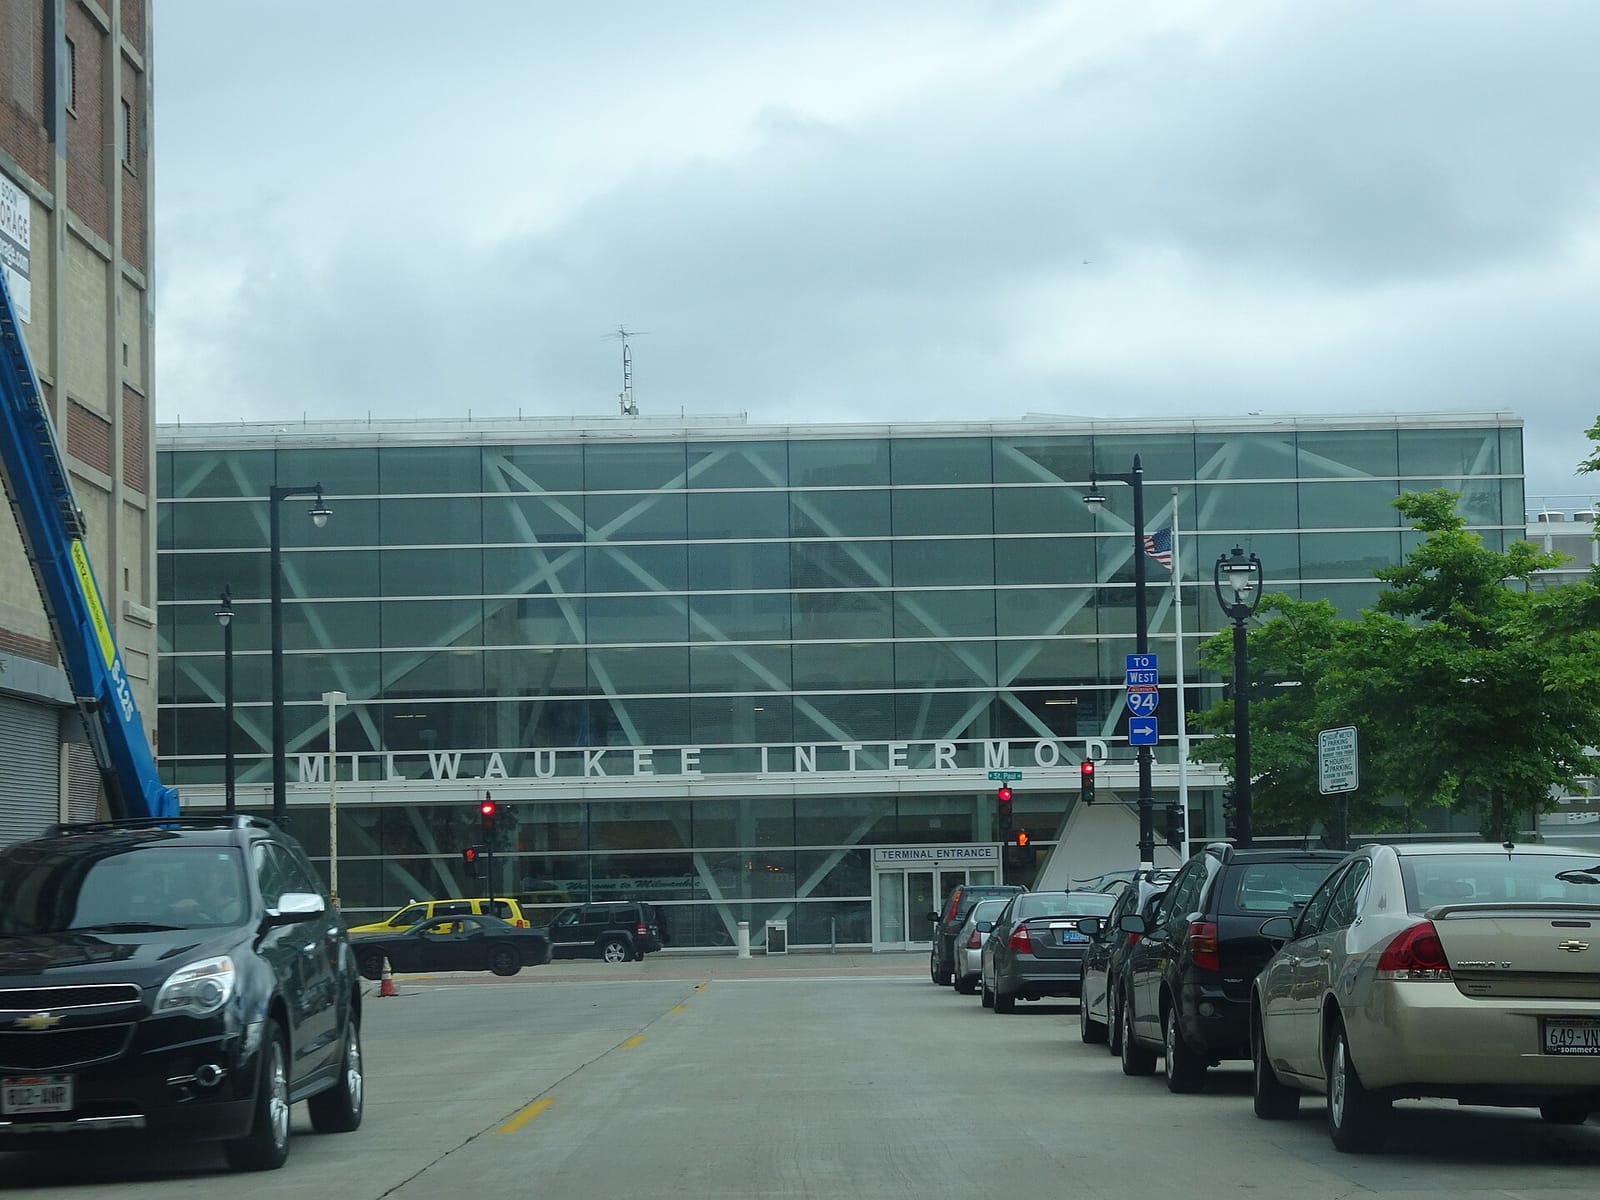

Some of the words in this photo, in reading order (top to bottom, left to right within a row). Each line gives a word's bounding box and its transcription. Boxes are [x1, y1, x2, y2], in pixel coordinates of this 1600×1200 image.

[1133, 657, 1149, 667] TO
[1130, 672, 1155, 683] WEST
[1130, 694, 1155, 710] 94
[1328, 738, 1349, 746] PARKING
[302, 748, 702, 783] MILWAUKEE
[1324, 759, 1330, 773] 5
[1330, 763, 1353, 773] PARKING
[881, 850, 933, 860] TERMINAL
[936, 848, 991, 858] ENTRANCE
[620, 881, 631, 889] to
[634, 878, 700, 889] Milauke
[1550, 1028, 1600, 1047] 649-VN
